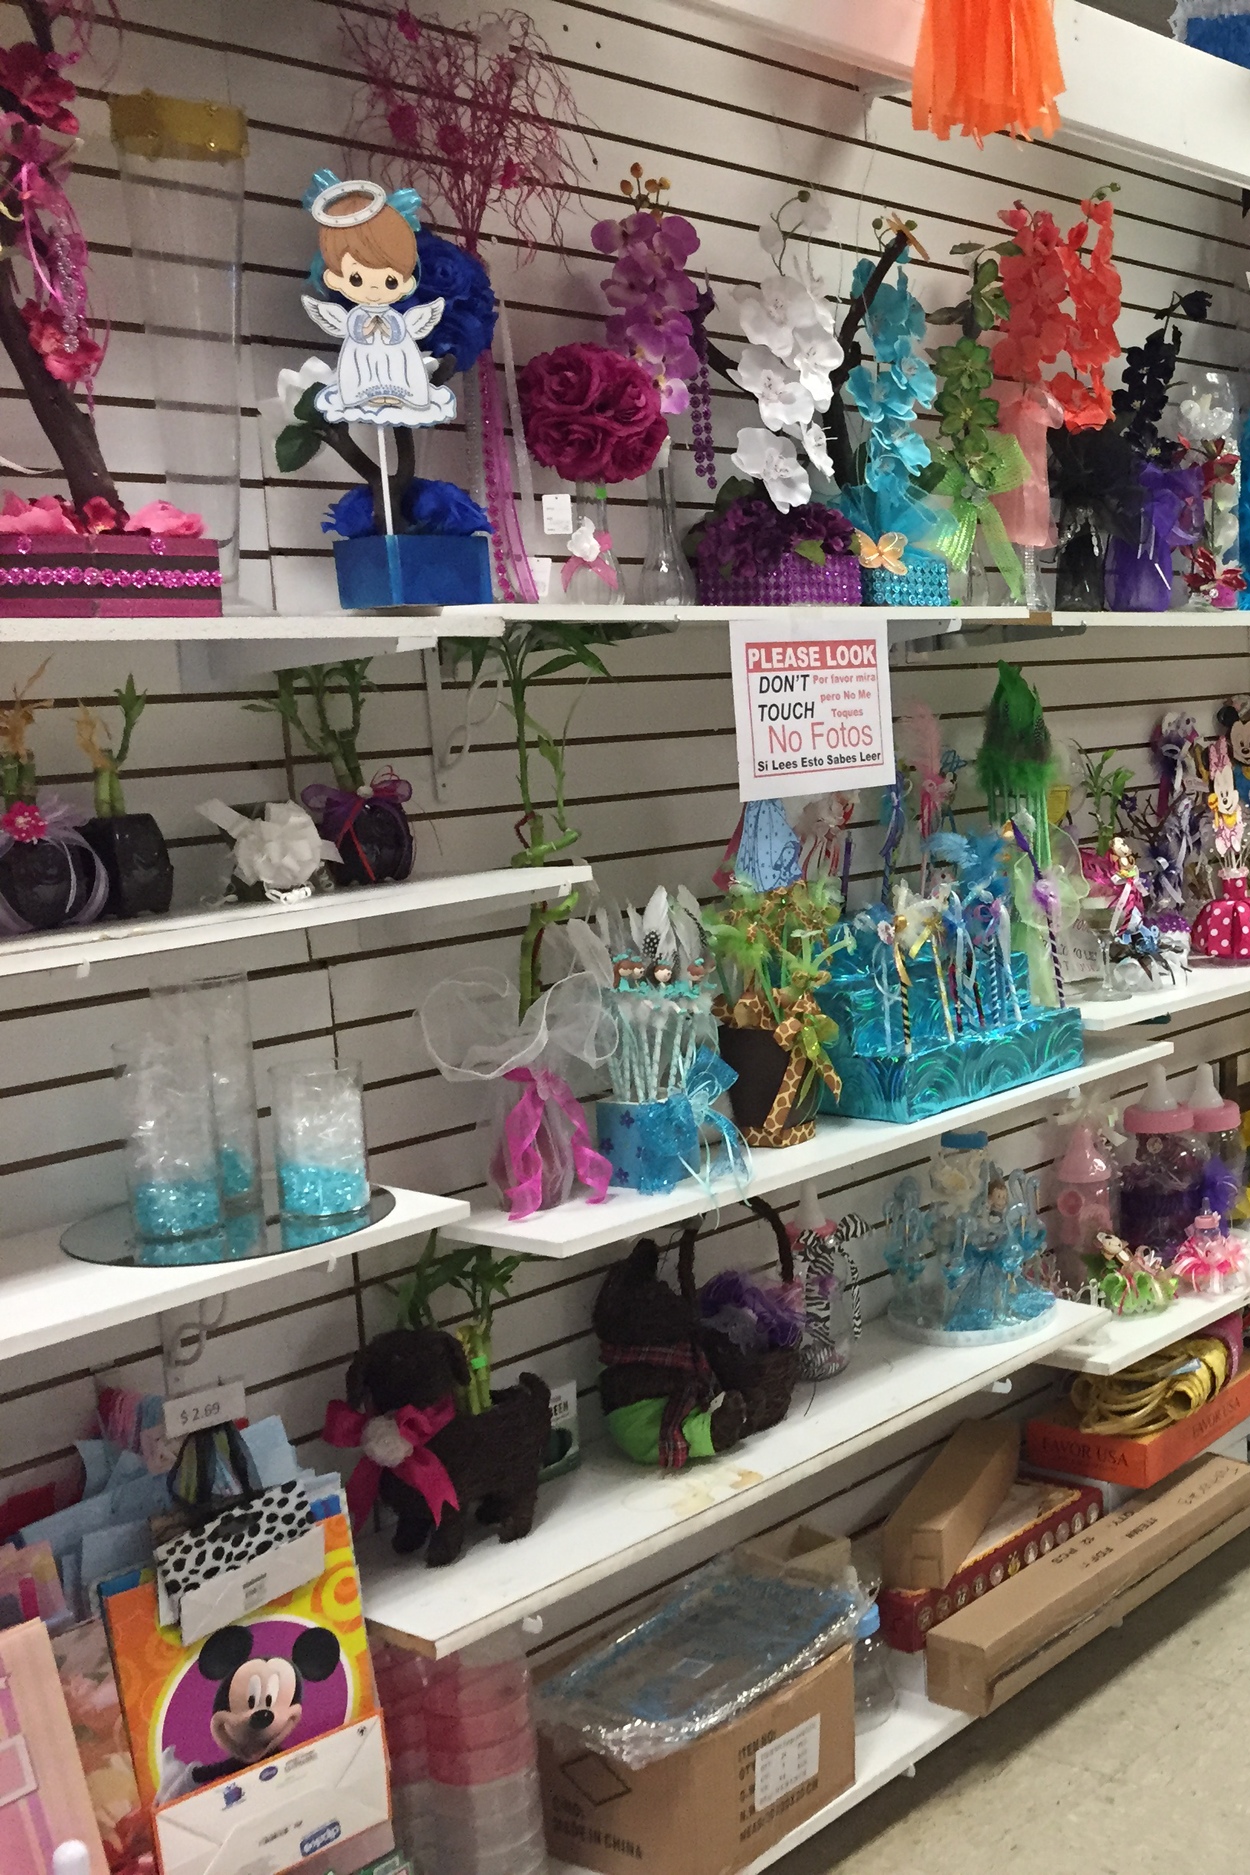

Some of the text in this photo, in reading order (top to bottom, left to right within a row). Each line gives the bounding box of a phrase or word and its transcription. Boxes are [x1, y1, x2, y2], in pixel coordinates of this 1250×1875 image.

[748, 645, 876, 669] PLEASE LOOK
[759, 674, 810, 694] DON'T
[813, 672, 876, 684] Por favor mira
[820, 689, 871, 703] pero No Me
[758, 701, 815, 722] TOUCH
[831, 707, 863, 719] Toques
[769, 722, 873, 754] No Fotos
[772, 758, 798, 771] Lees
[801, 756, 824, 768] Esto
[827, 753, 857, 765] Sabes
[860, 751, 881, 763] Leer
[192, 1402, 220, 1421] 2.69
[1042, 1437, 1128, 1468] FAVOR USA
[604, 1833, 643, 1860] CHINA
